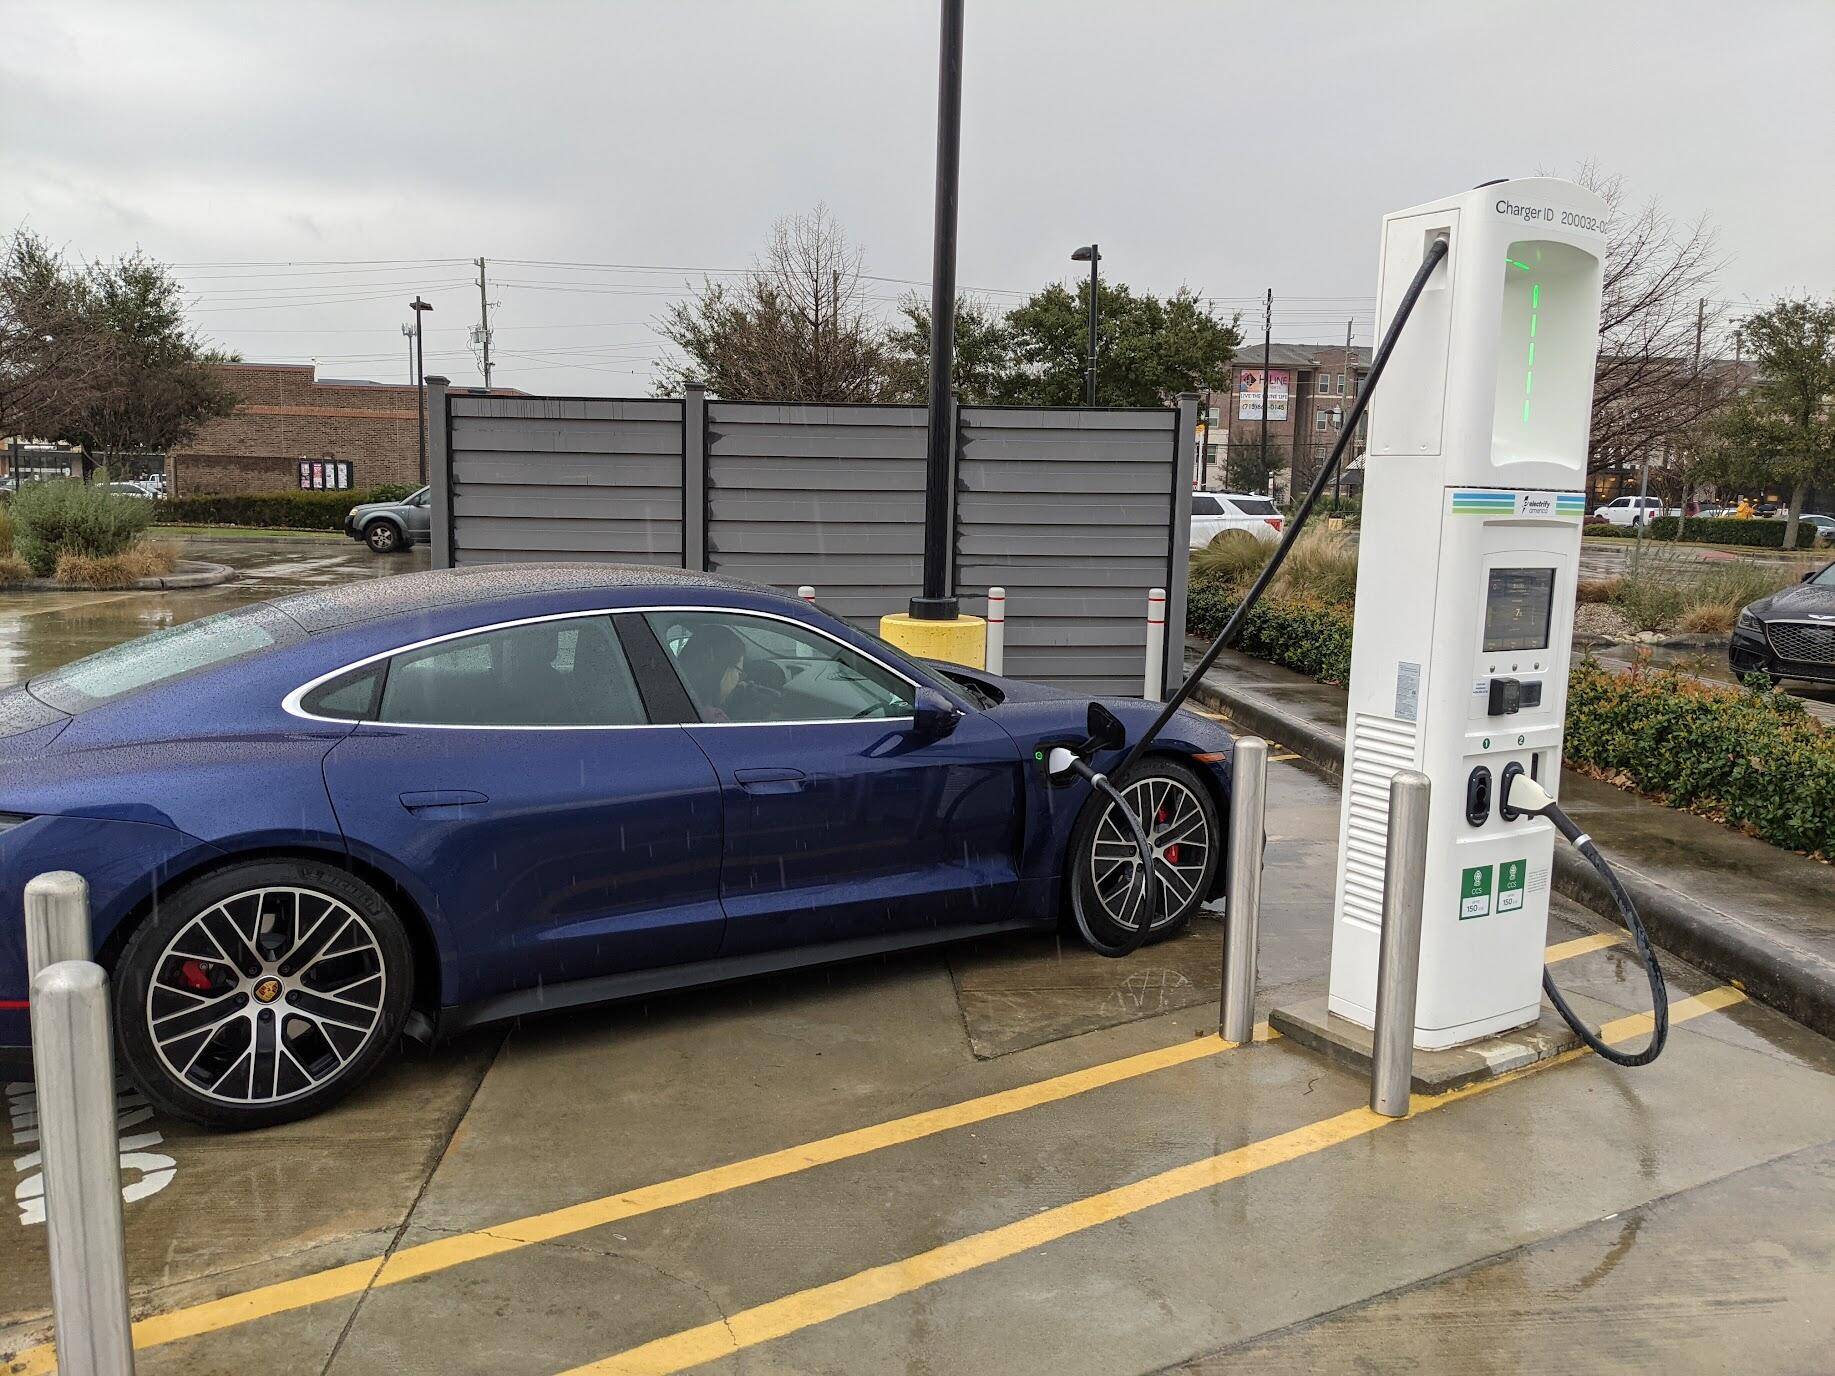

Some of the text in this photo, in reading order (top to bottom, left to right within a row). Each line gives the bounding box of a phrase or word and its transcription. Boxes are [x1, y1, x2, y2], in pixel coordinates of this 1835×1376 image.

[1496, 200, 1541, 221] Charger
[1544, 207, 1554, 221] ID
[1528, 500, 1550, 508] electrify
[1507, 881, 1517, 889] CCS
[1471, 887, 1482, 895] CCS
[1503, 898, 1512, 906] 150
[1466, 904, 1478, 912] 150
